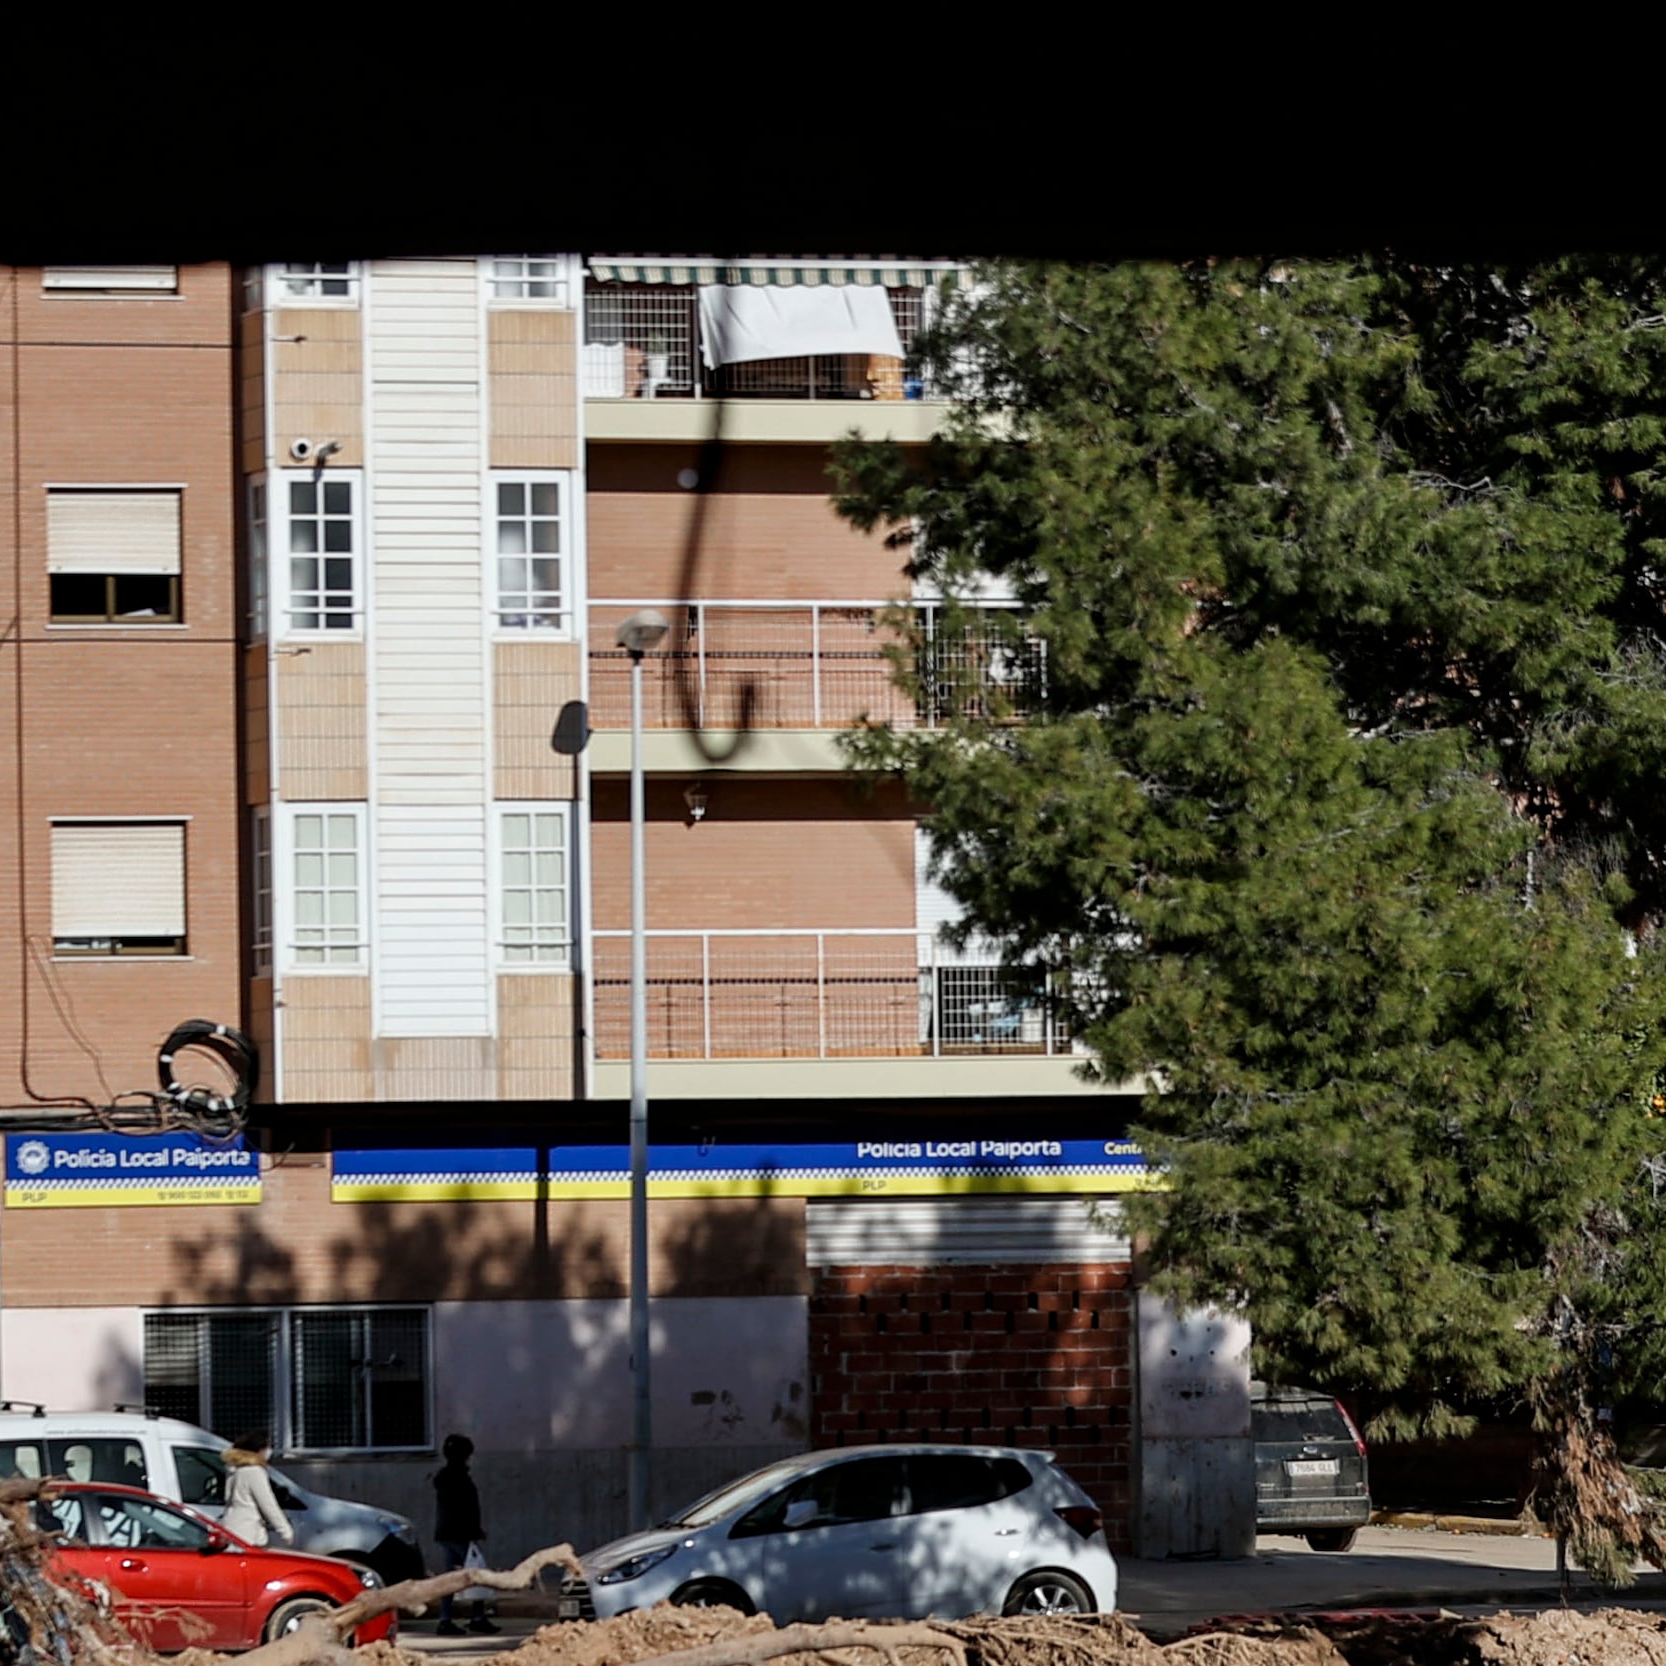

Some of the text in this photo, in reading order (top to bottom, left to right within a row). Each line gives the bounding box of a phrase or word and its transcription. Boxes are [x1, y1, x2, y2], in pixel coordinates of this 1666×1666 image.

[926, 1141, 975, 1158] Local
[981, 1140, 1061, 1160] Paiporta
[1104, 1141, 1142, 1155] Cent
[120, 1148, 169, 1168] Local
[172, 1147, 251, 1170] Paiporta
